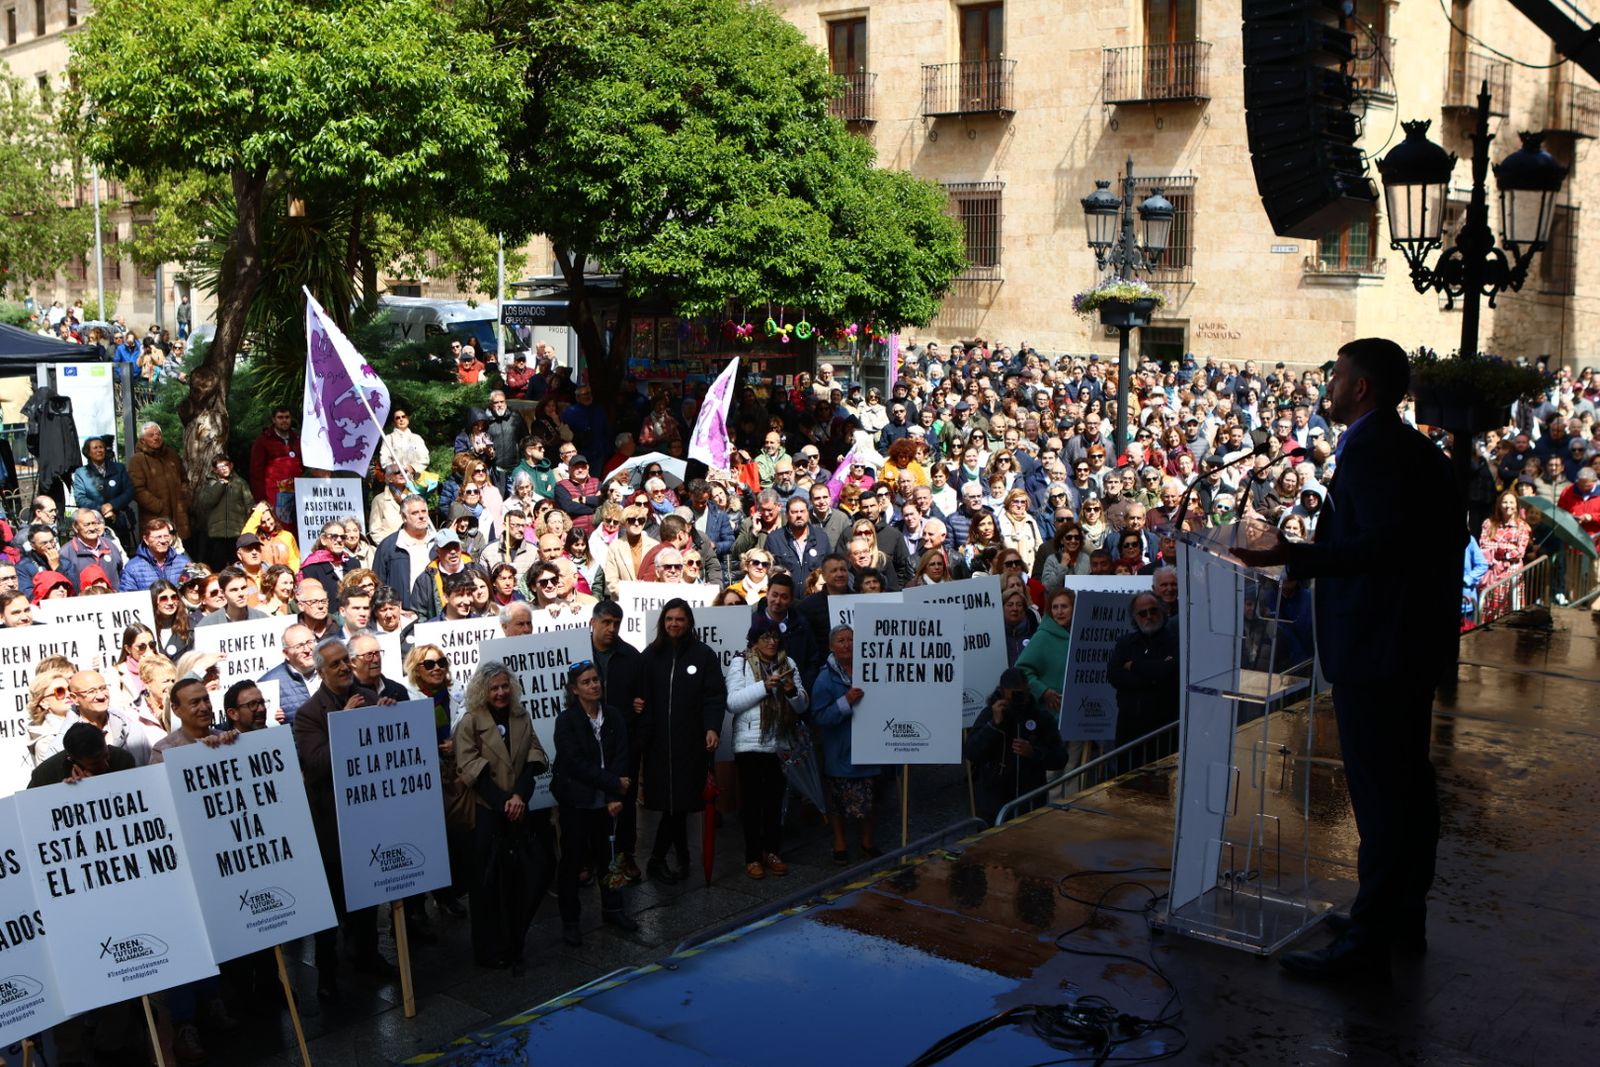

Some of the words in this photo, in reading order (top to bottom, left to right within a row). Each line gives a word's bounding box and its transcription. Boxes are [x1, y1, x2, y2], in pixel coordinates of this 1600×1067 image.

[505, 306, 517, 316] LOS
[518, 306, 546, 316] BANDOS
[312, 486, 333, 497] MIRA
[337, 486, 346, 497] LA
[627, 617, 641, 632] DE
[1092, 606, 1113, 621] MIRA
[1116, 606, 1126, 621] LA
[875, 619, 943, 637] PORTUGAL
[38, 641, 79, 660] RUTA
[219, 635, 256, 653] RENFE
[261, 632, 276, 648] YA
[861, 639, 894, 659] ESTÁ
[899, 641, 915, 659] AL
[921, 641, 955, 662] LADO,
[228, 656, 269, 676] BASTA,
[502, 647, 573, 673] PORTUGAL
[13, 669, 29, 689] LA
[862, 662, 879, 683] EL
[886, 663, 926, 683] TREN
[933, 663, 954, 683] NO
[532, 676, 548, 694] AL
[521, 696, 561, 720] TREN
[358, 727, 372, 747] LA
[378, 721, 410, 743] RUTA
[183, 758, 243, 793] RENFE
[248, 749, 285, 778] NOS
[346, 757, 361, 777] DE
[367, 754, 380, 773] LA
[386, 747, 426, 770] PLATA,
[203, 787, 247, 819] DEJA
[252, 780, 278, 806] EN
[346, 782, 377, 806] PARA
[382, 779, 396, 798] EL
[400, 772, 432, 795] 2040
[51, 790, 149, 831] PORTUGAL
[230, 811, 265, 842] VÍA
[37, 828, 88, 865] ESTÁ
[95, 826, 118, 848] AL
[122, 817, 173, 847] LADO,
[216, 836, 293, 878] MUERTA
[47, 868, 75, 898] EL
[81, 852, 140, 890] TREN
[147, 844, 177, 875] NO
